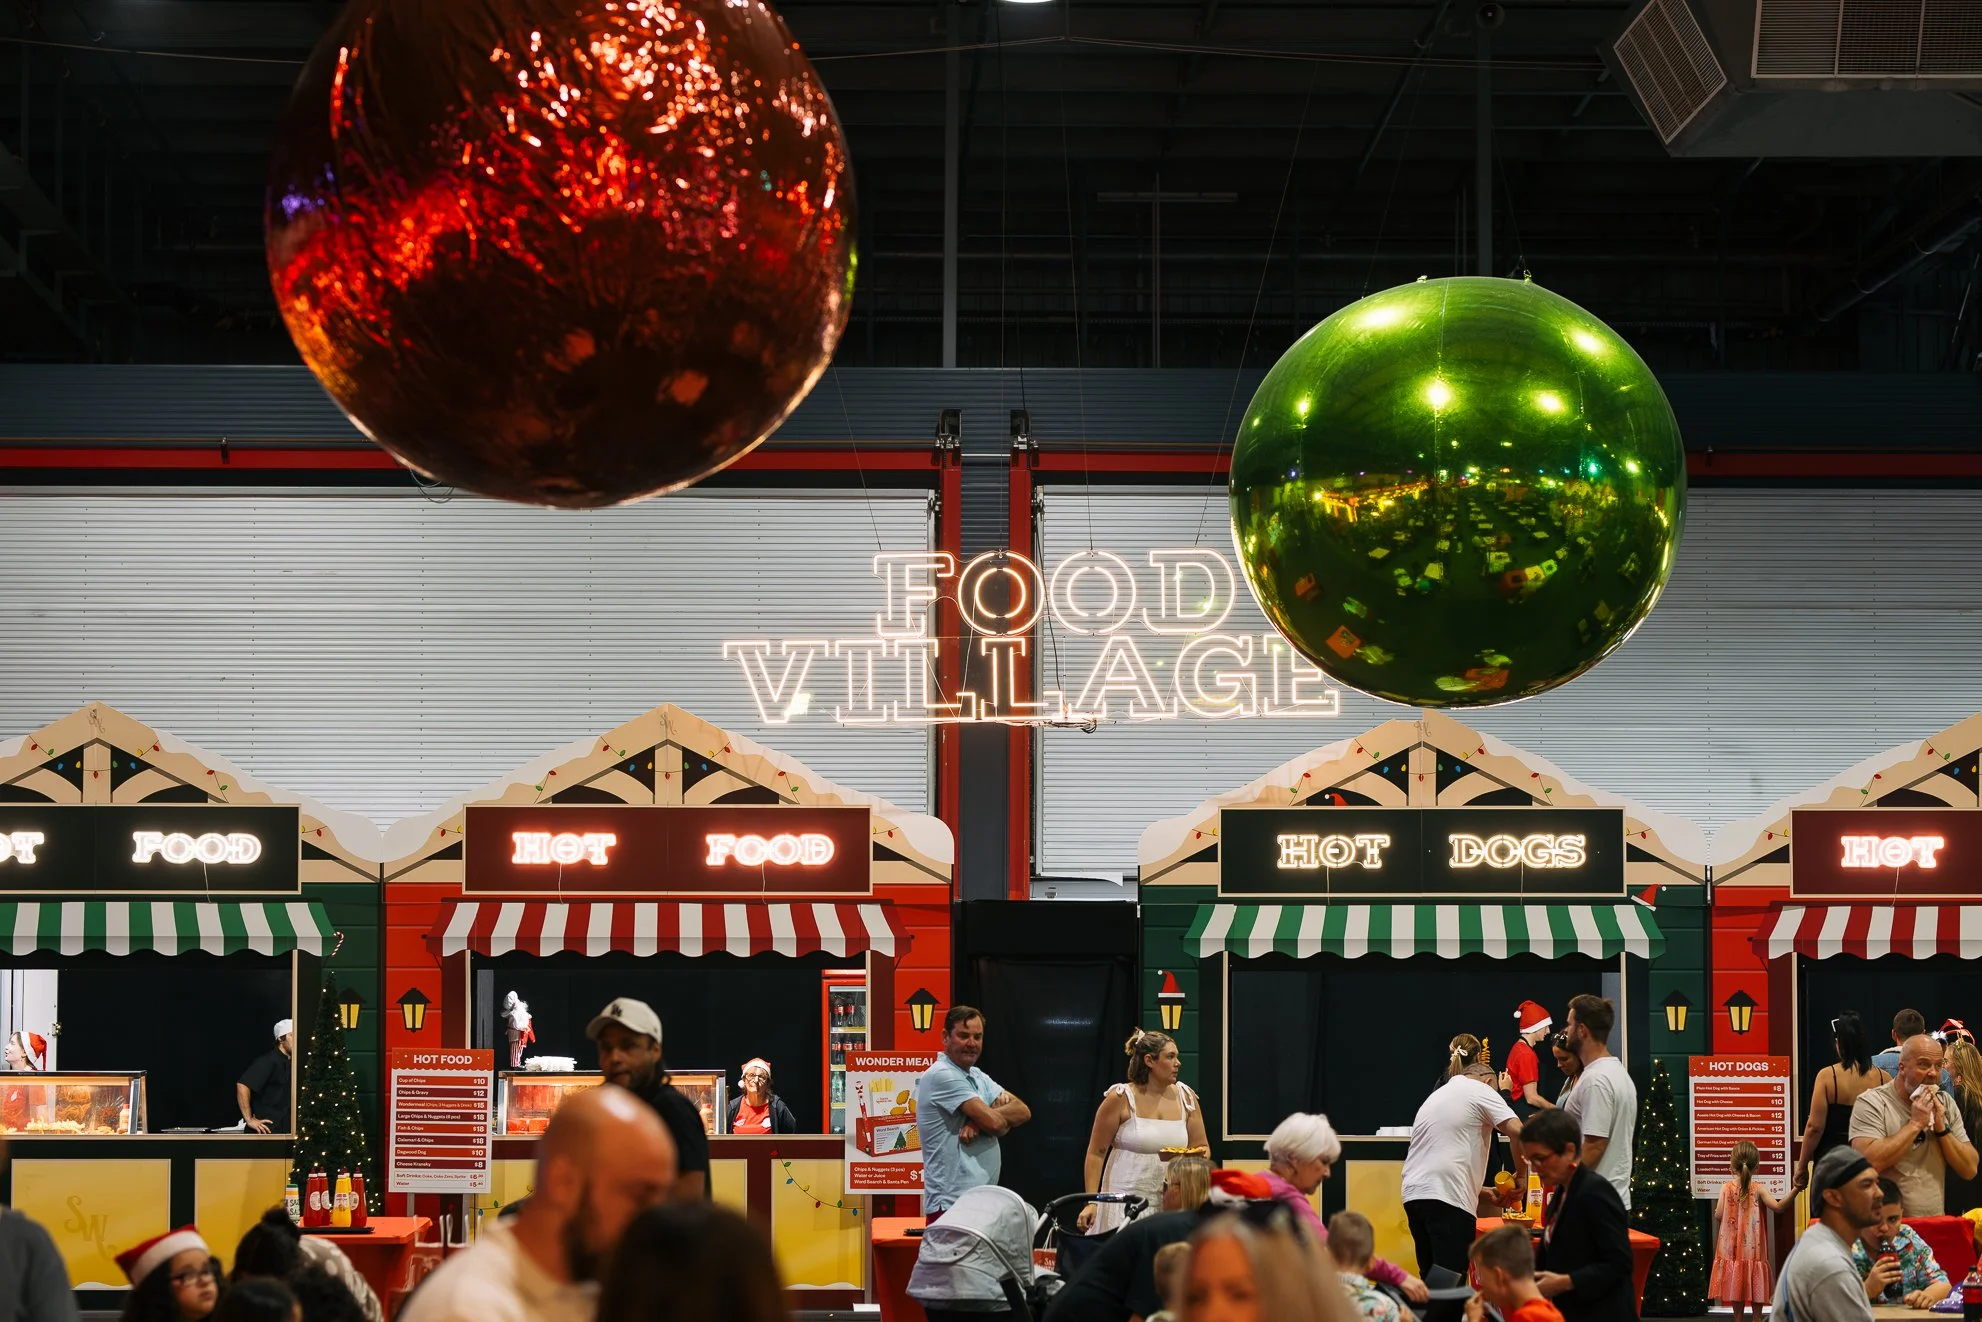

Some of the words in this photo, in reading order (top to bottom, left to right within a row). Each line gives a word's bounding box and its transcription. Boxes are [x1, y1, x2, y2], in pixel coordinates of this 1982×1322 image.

[874, 550, 1237, 637] FOOD
[723, 636, 1341, 724] VILLAGE
[132, 832, 262, 864] FOOD
[512, 832, 616, 864] HOT
[706, 834, 835, 866] FOOD
[1277, 834, 1390, 868] HOT
[1448, 834, 1586, 868] DOGS
[1841, 836, 1944, 868] HOT
[414, 1055, 438, 1064] HOT
[441, 1056, 472, 1064] FOOD
[855, 1058, 904, 1066] WONDER
[1709, 1062, 1734, 1070] HOT
[1736, 1062, 1769, 1071] DOGS
